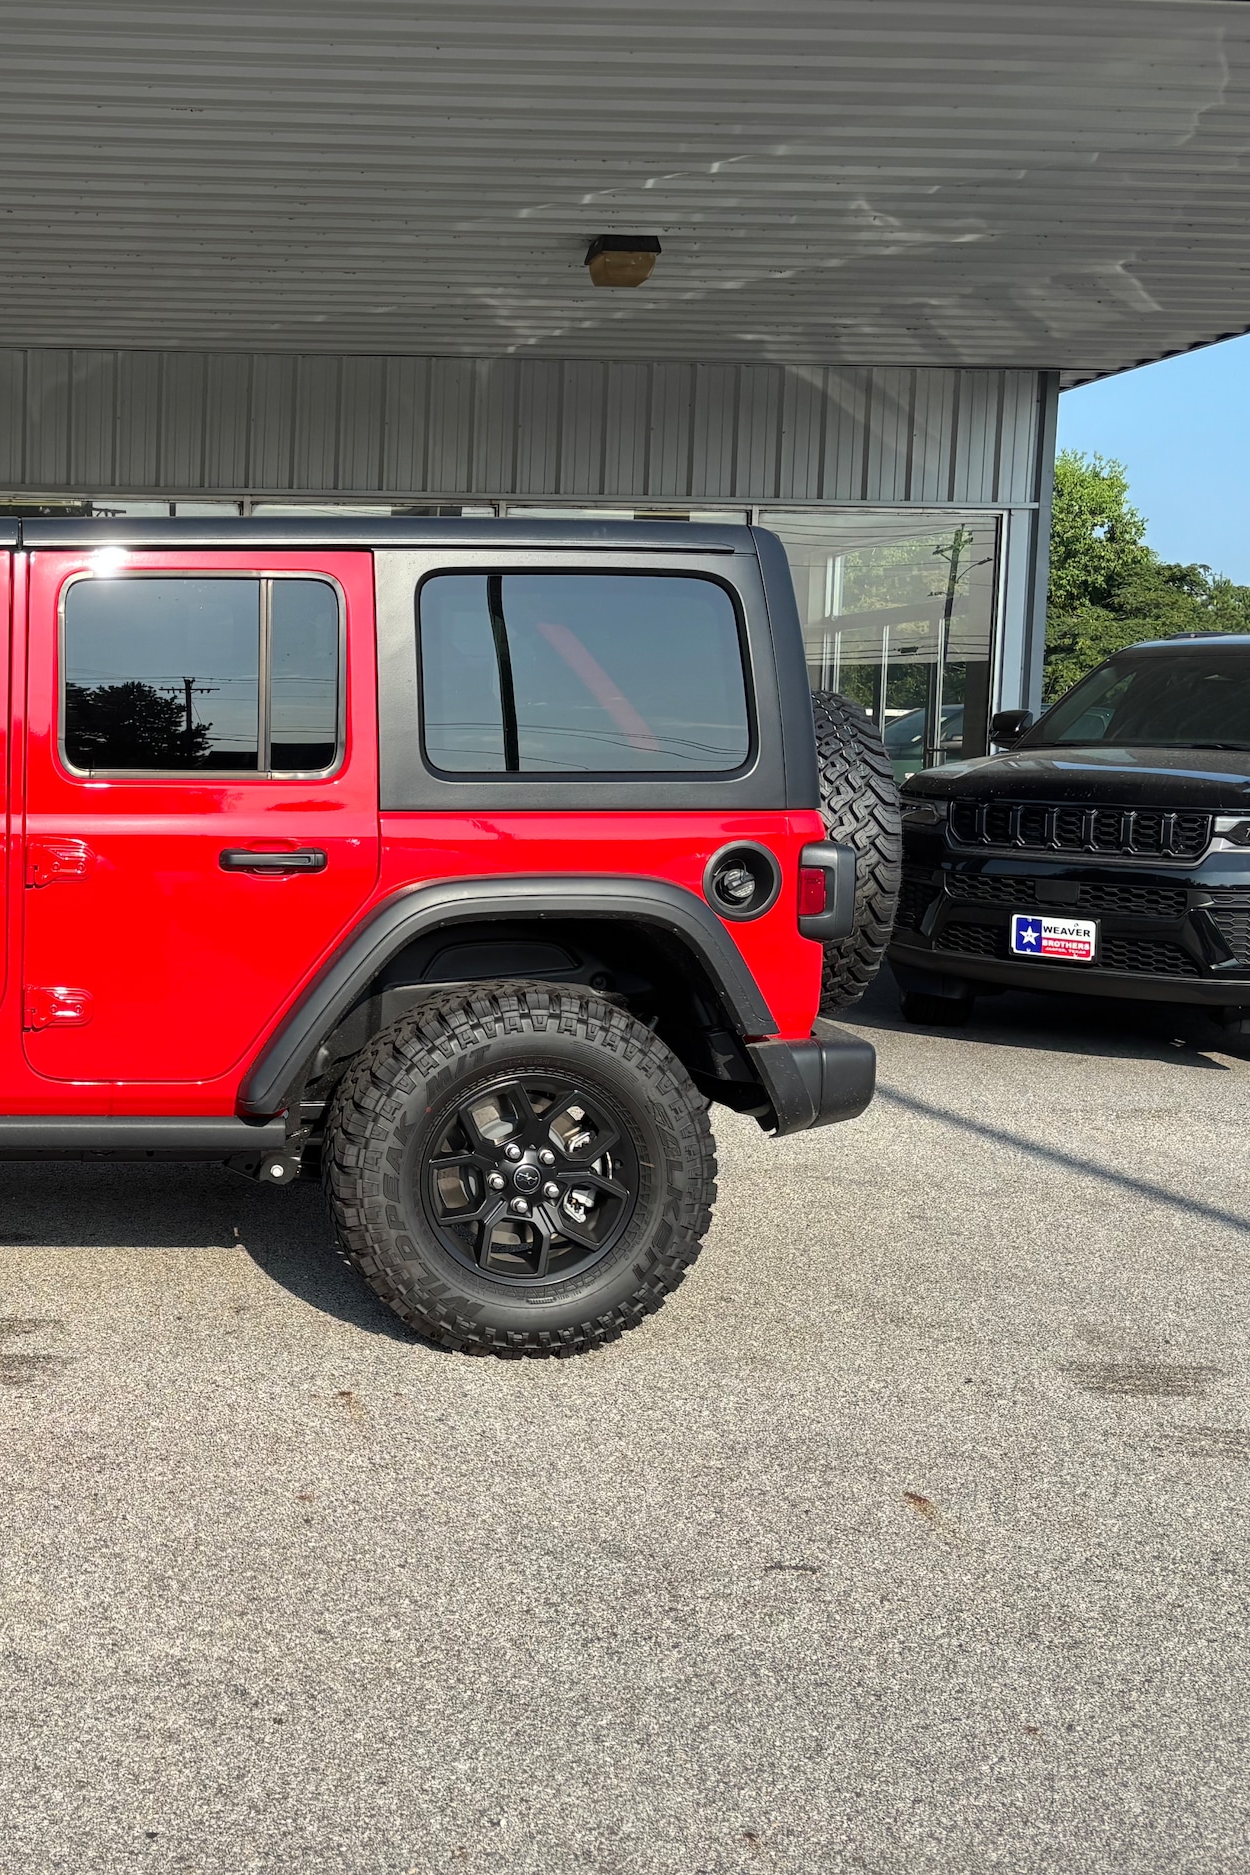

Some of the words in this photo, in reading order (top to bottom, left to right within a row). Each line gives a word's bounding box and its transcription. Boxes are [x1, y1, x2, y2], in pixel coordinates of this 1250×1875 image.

[1043, 926, 1091, 937] WEAVER
[1042, 939, 1090, 951] BROTHERS
[382, 1111, 485, 1318] WILDPEAK
